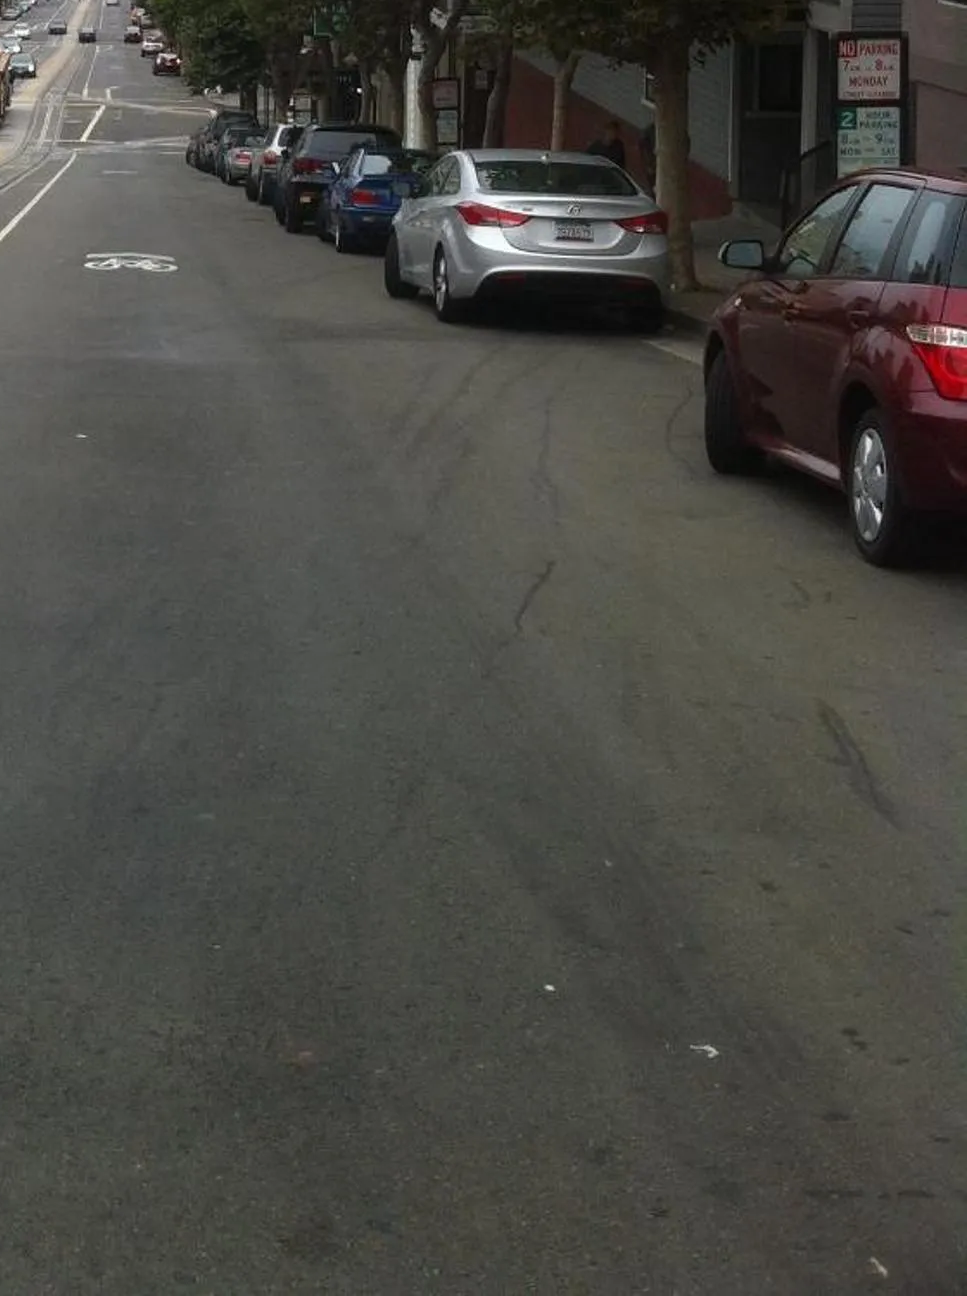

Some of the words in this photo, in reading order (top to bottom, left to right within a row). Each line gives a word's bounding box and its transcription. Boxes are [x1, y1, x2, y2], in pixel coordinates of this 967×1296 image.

[839, 40, 855, 56] NO
[859, 42, 899, 56] PARKING
[848, 76, 888, 88] MONDAY
[840, 111, 854, 128] 2
[859, 120, 898, 129] PARKING
